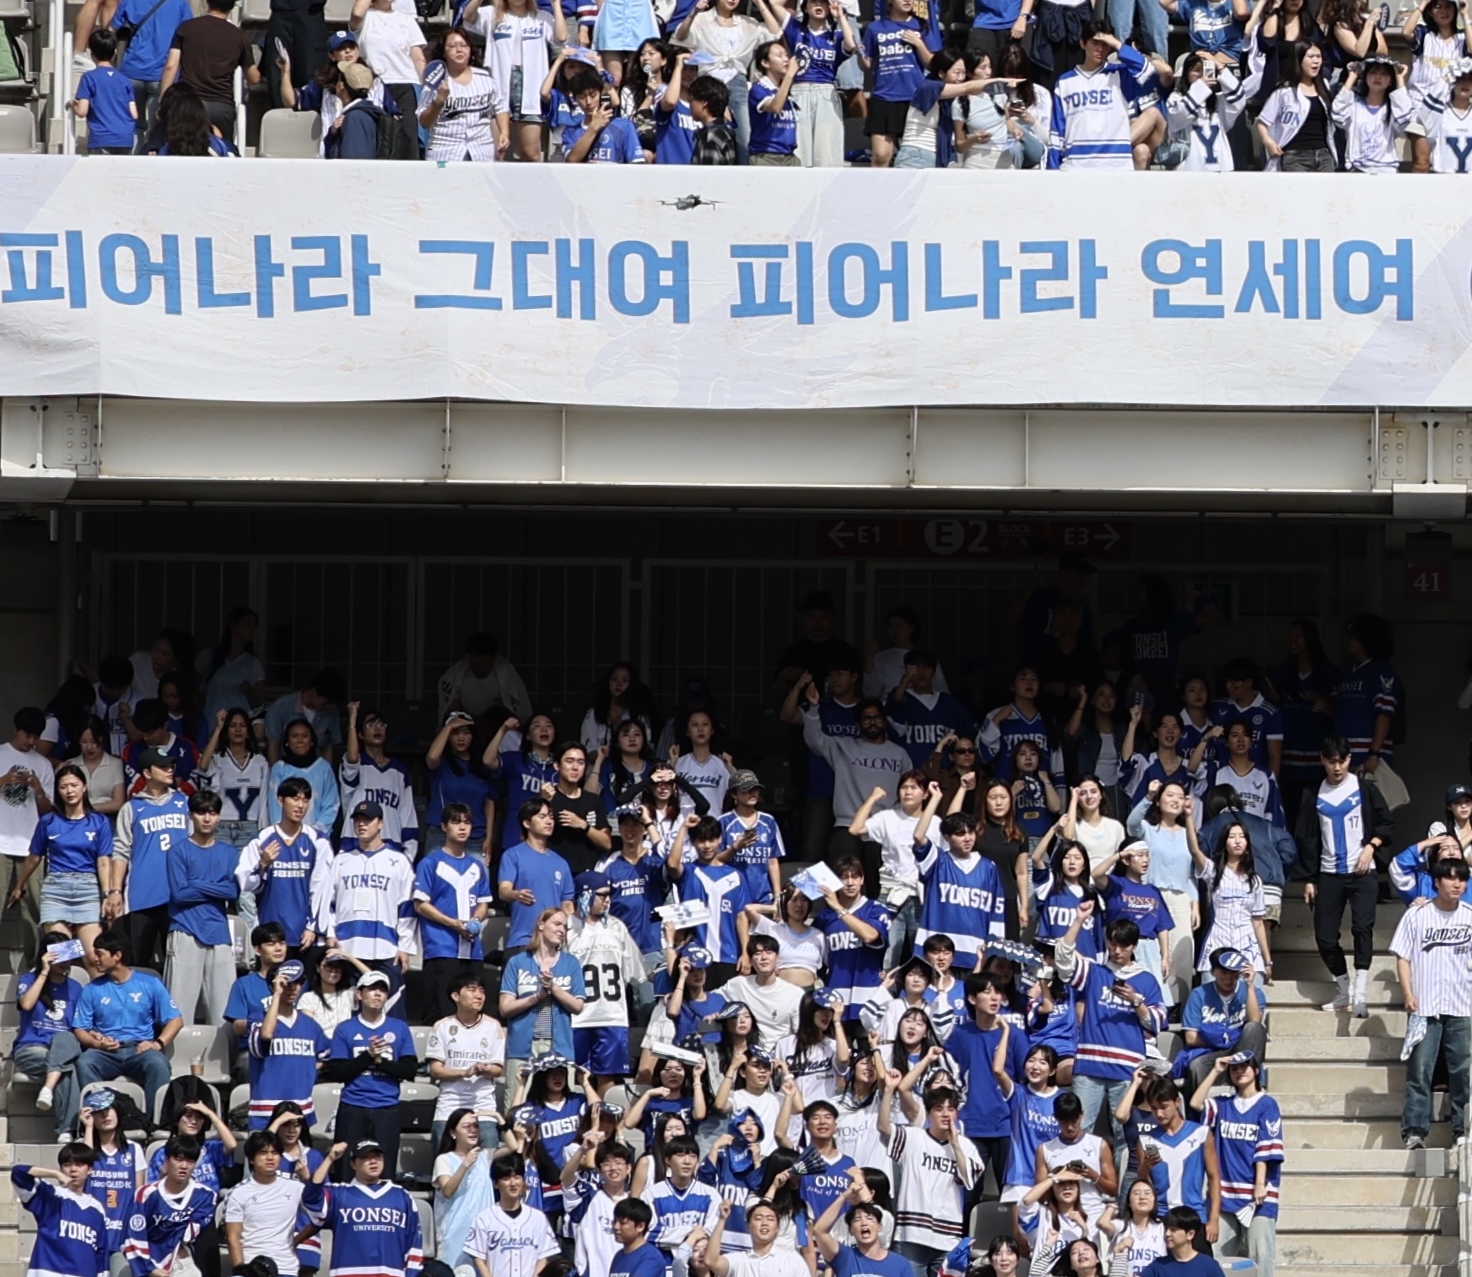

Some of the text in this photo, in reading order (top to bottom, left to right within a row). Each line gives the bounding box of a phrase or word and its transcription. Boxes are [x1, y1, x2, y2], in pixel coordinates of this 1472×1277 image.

[0, 233, 1415, 326] 피어나라 그대여 피어나라 연세여
[856, 524, 882, 544] E1
[998, 524, 1031, 534] BLOCK
[1064, 526, 1089, 545] E3
[1413, 571, 1441, 592] 41
[140, 814, 186, 833] YONSEI
[160, 834, 170, 850] 2
[342, 874, 390, 891] YONSEI
[940, 883, 992, 912] YONSEI
[584, 964, 622, 1001] 93
[339, 1207, 406, 1227] YONSEI
